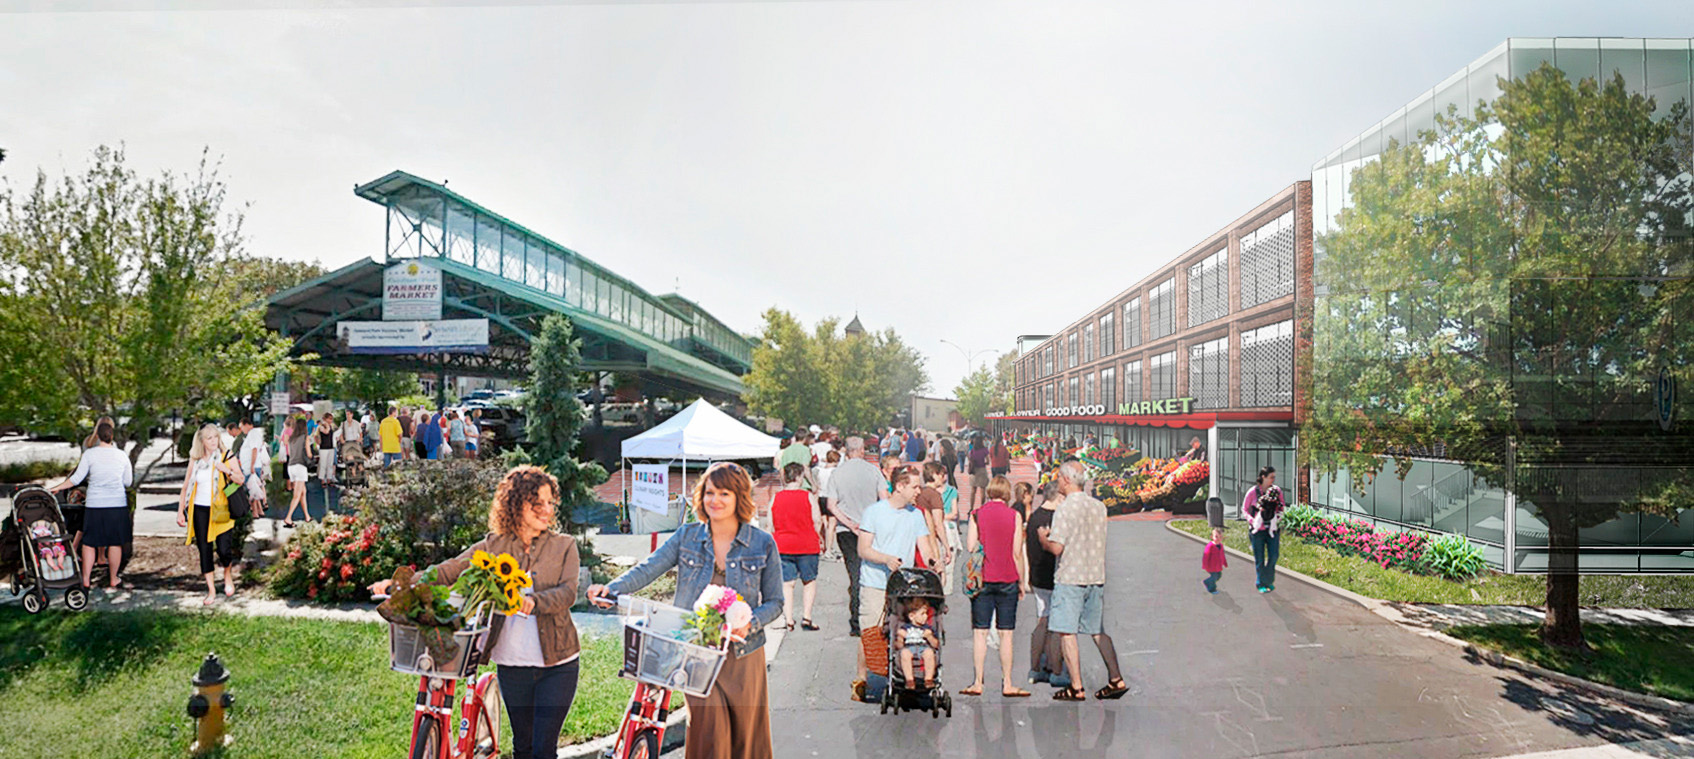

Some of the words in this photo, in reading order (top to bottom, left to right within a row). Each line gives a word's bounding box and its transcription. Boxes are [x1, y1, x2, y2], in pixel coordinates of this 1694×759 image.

[389, 291, 436, 299] MARKET
[1045, 406, 1070, 417] GOOD
[1072, 404, 1106, 416] FOOD
[1118, 397, 1194, 416] MARKET
